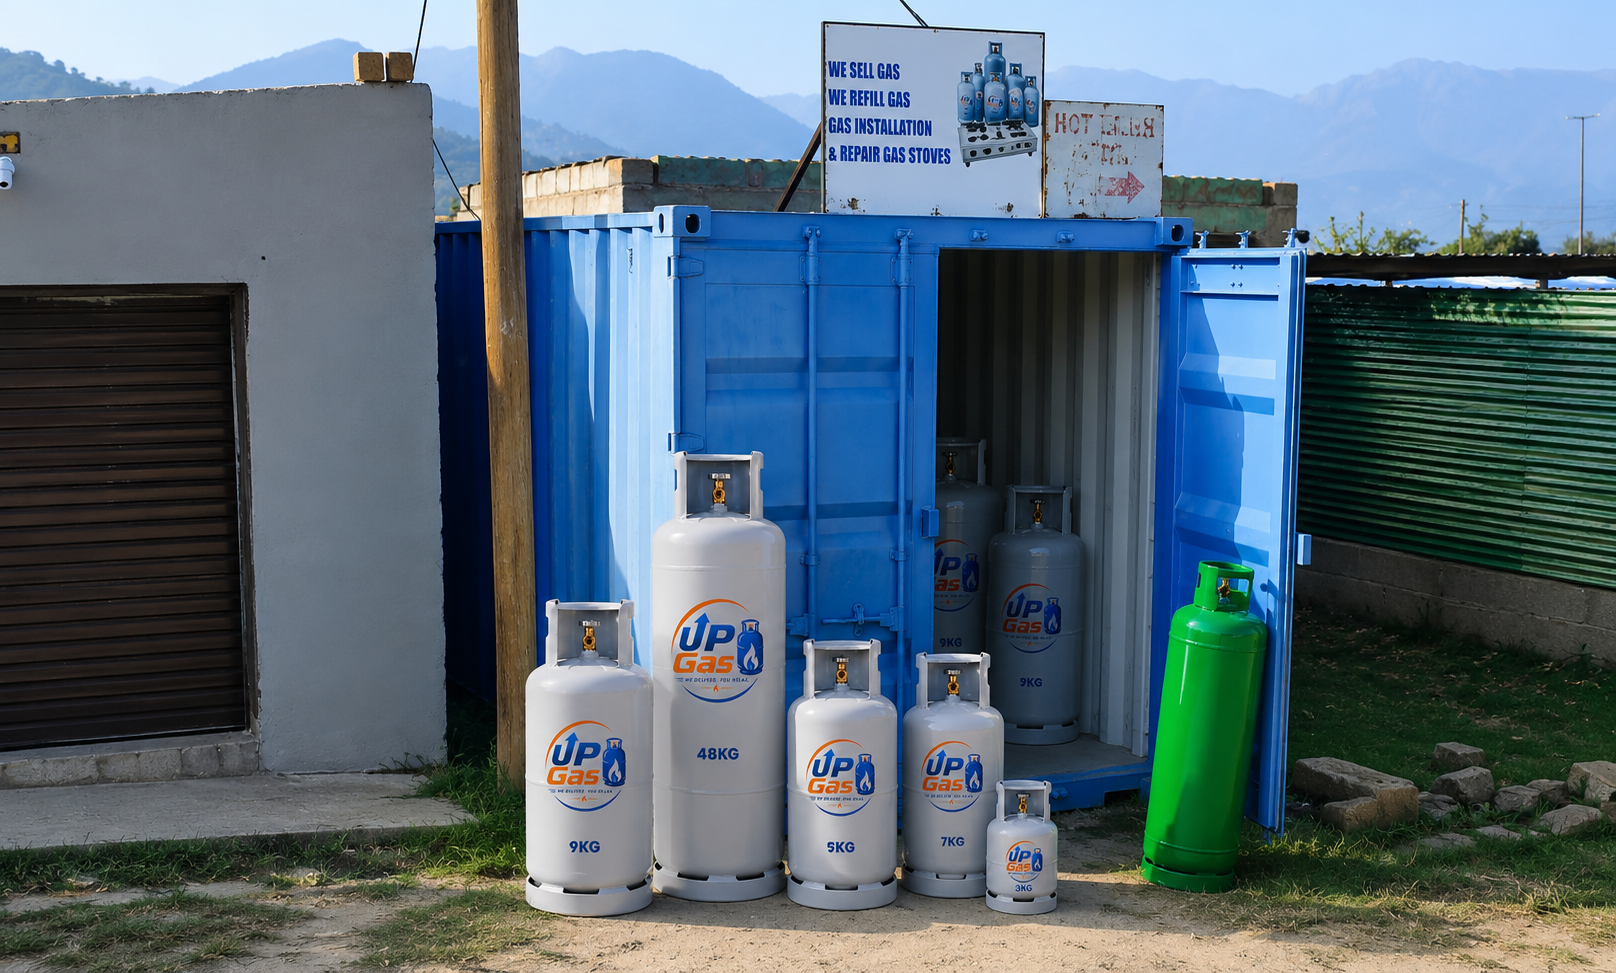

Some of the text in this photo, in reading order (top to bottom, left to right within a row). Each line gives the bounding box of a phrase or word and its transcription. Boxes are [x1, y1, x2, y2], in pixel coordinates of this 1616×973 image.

[828, 60, 900, 80] WE SELL GAS
[828, 88, 911, 108] WE REFILL GAS
[828, 116, 932, 137] GAS INSTALLATION
[1054, 112, 1093, 135] HOT
[828, 144, 951, 165] & REPAIR GAS STOVES
[934, 578, 961, 592] as
[1006, 592, 1043, 618] UP
[679, 612, 735, 652] UP
[1002, 618, 1042, 634] Gas
[940, 638, 962, 648] 9KG
[672, 652, 735, 674] Gas
[1020, 677, 1043, 688] 9KG
[552, 732, 601, 766] UP
[696, 747, 740, 761] 48KG
[812, 748, 854, 778] UP
[926, 749, 964, 776] UP
[546, 766, 601, 786] Gas
[922, 776, 964, 792] Gas
[807, 778, 854, 795] Gas
[569, 840, 601, 853] 9KG
[826, 841, 856, 854] 5KG
[940, 836, 965, 847] 7KG
[1008, 845, 1032, 863] UP
[1006, 861, 1031, 872] Gas
